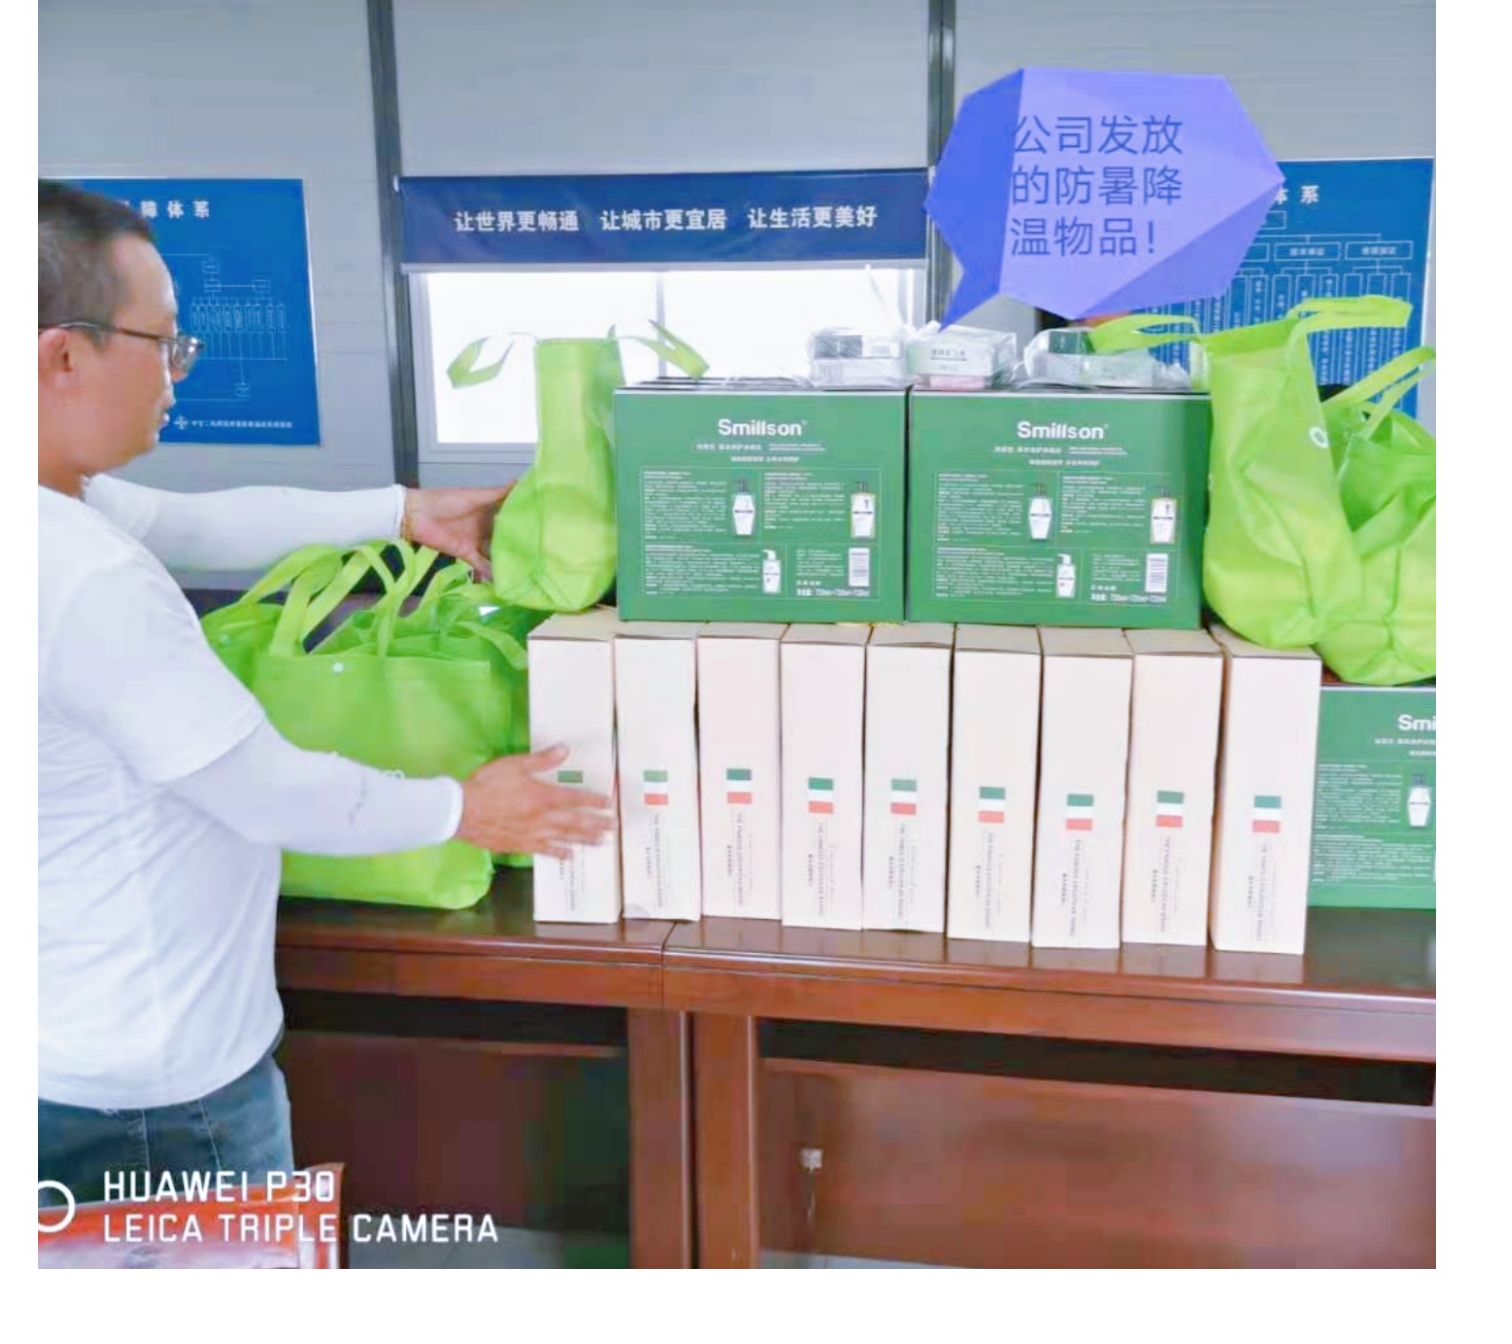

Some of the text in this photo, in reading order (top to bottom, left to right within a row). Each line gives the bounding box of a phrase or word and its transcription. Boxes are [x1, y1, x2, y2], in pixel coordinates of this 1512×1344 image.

[454, 205, 878, 232] 让世界更畅通 让城市更宜居 让生活更美好
[717, 418, 803, 436] Smillson
[1017, 421, 1104, 440] Smillson
